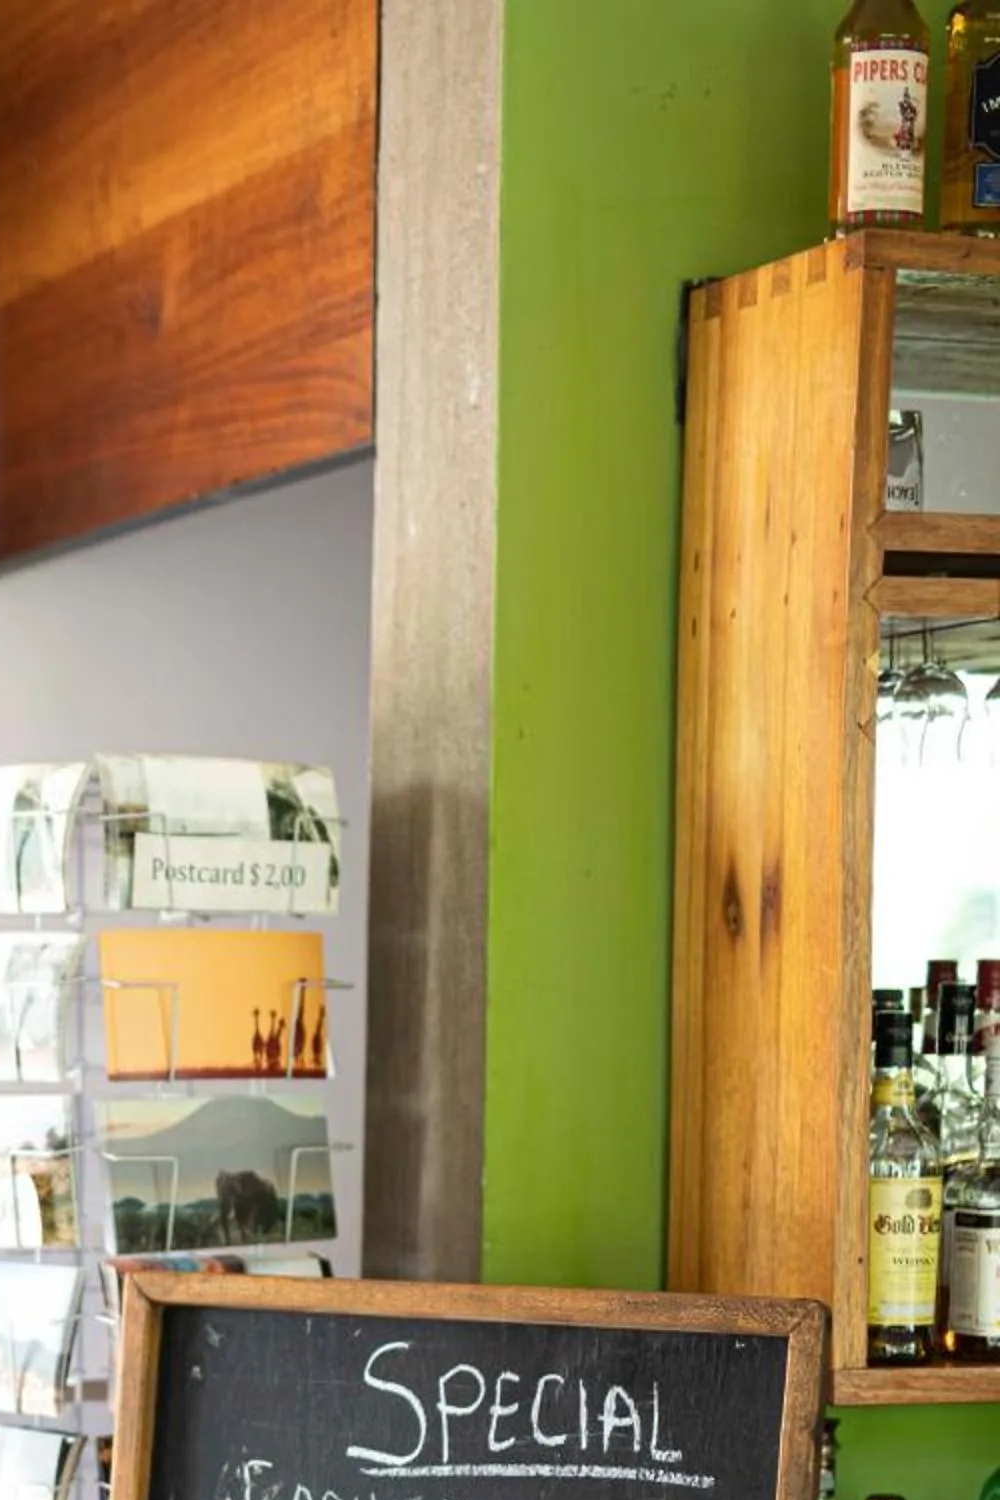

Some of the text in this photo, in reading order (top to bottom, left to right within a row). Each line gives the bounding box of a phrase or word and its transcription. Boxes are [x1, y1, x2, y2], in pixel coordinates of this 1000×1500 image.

[854, 59, 909, 83] PIPERS
[152, 857, 245, 886] Postcard
[345, 1340, 684, 1466] SPECIAL
